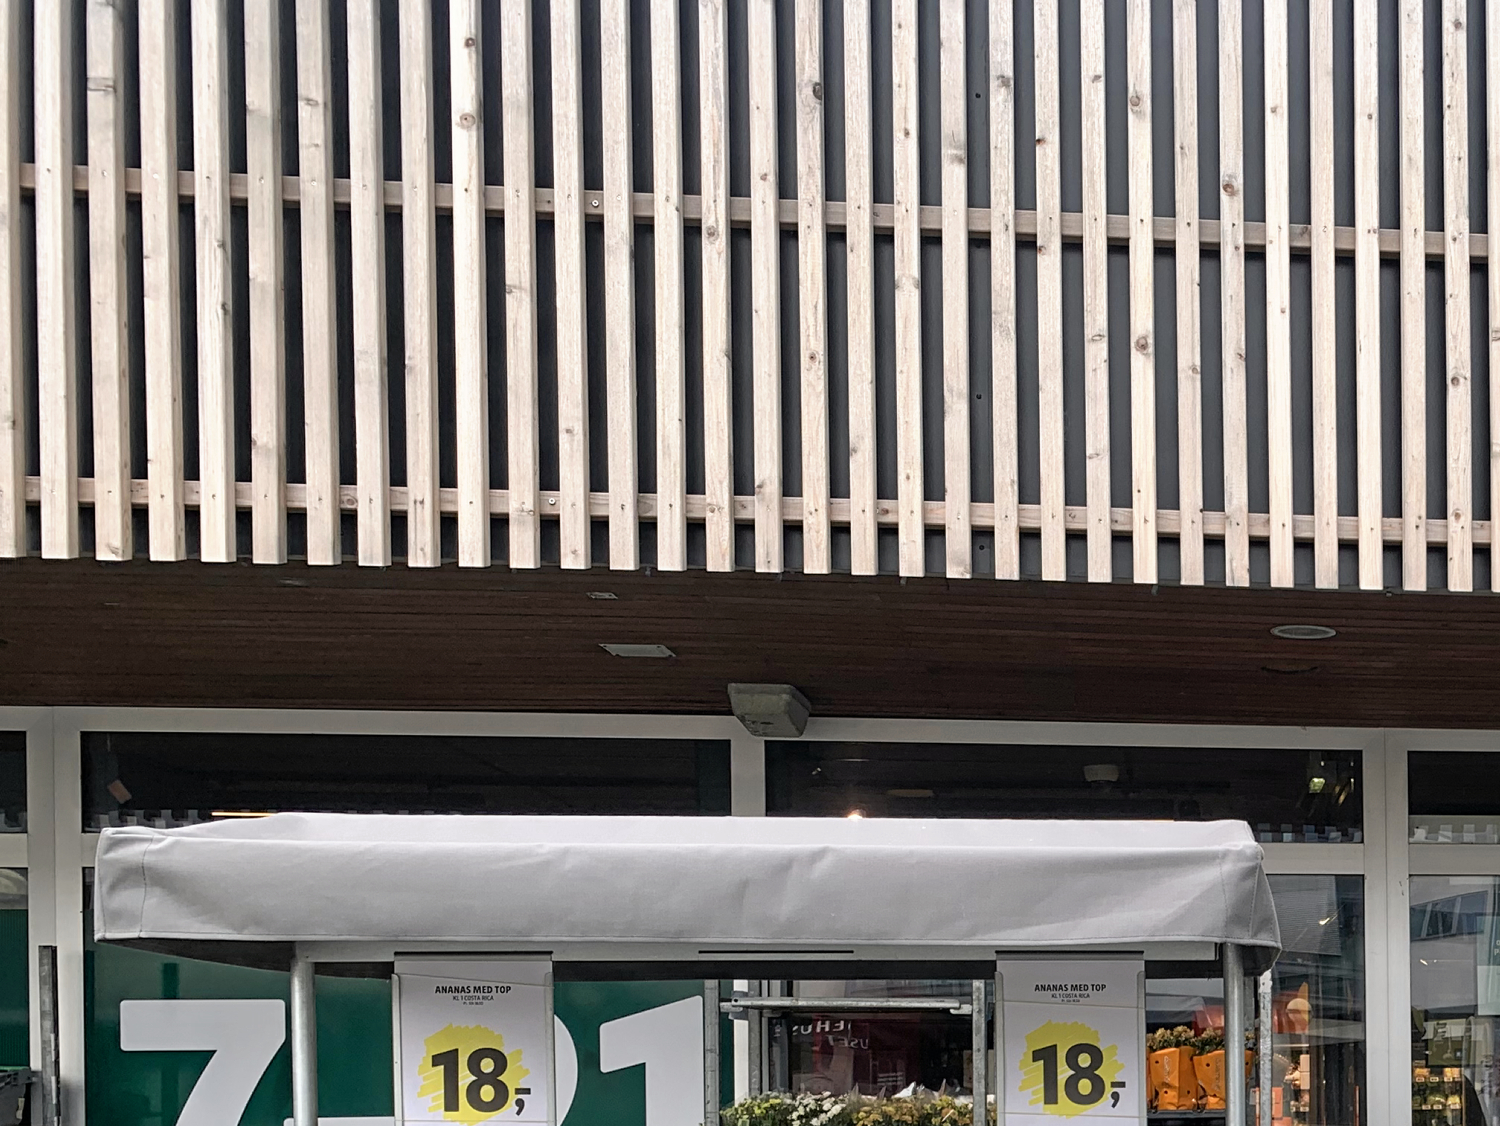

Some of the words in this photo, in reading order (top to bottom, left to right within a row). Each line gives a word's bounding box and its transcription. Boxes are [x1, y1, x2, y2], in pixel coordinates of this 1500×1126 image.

[434, 985, 472, 995] ANANAS
[473, 985, 493, 994] MED
[495, 985, 512, 994] TOP
[1034, 983, 1069, 992] ANANAS
[1070, 983, 1089, 992] MED
[1091, 983, 1107, 992] TOP
